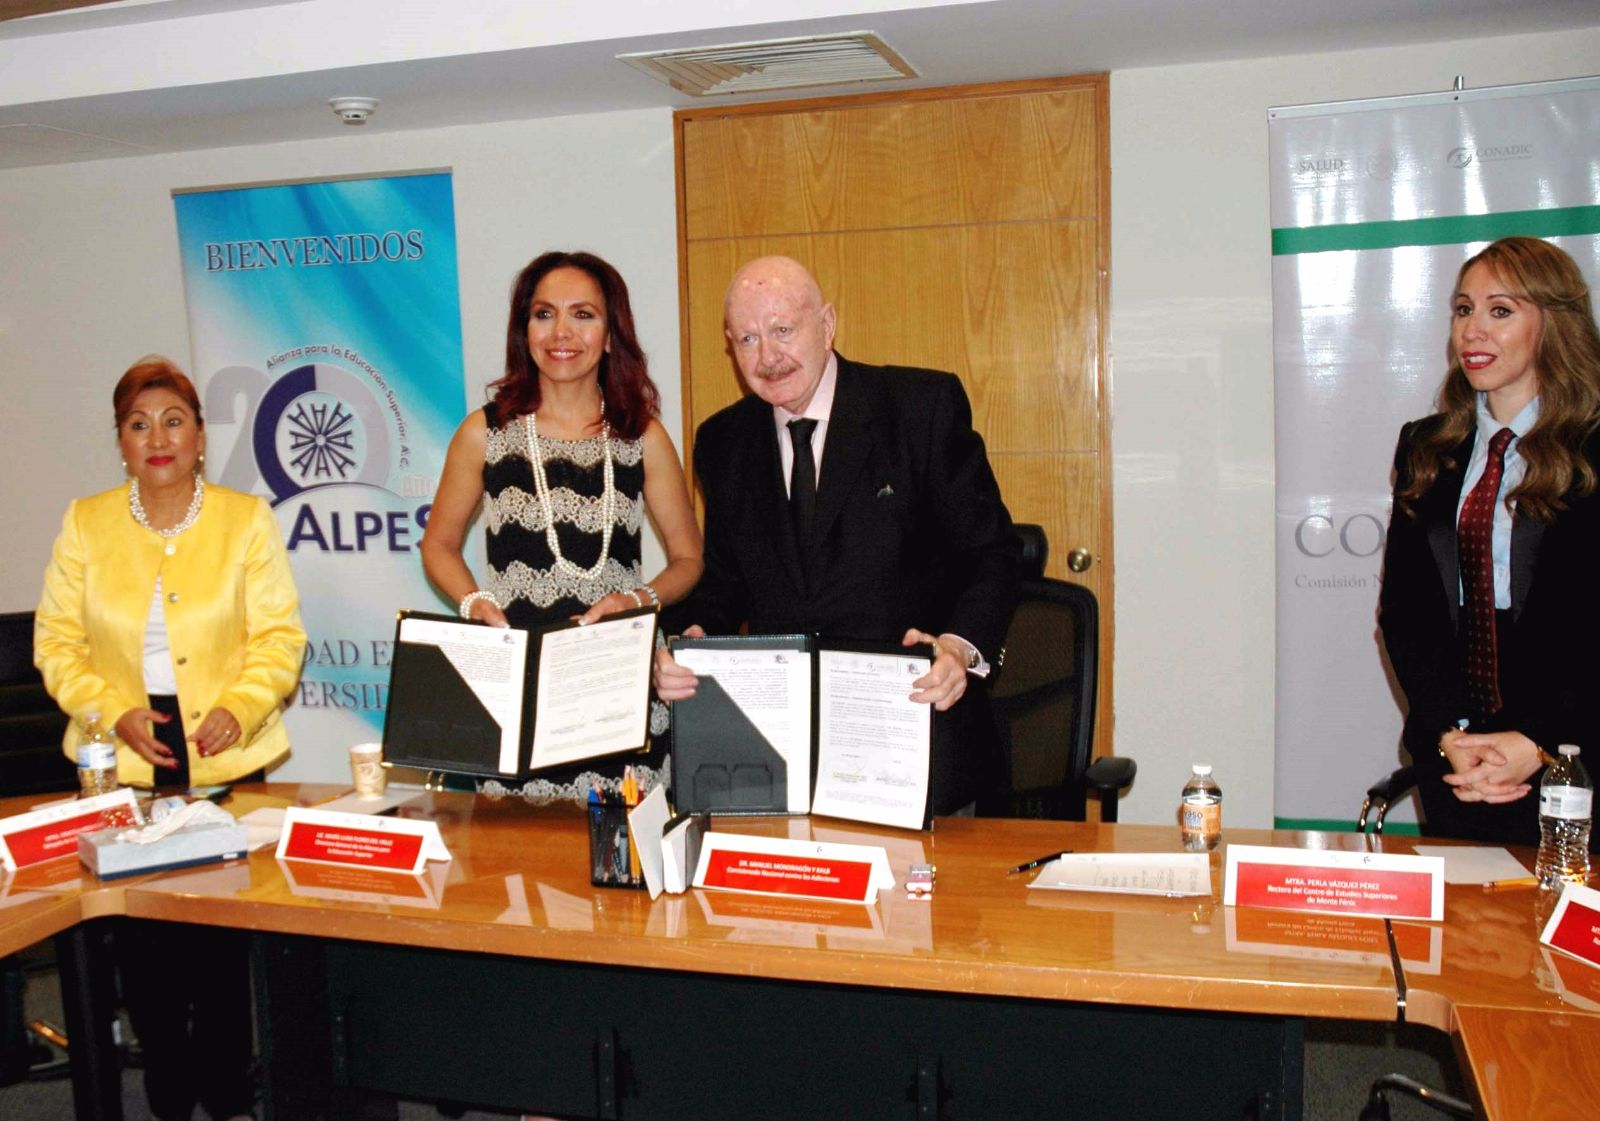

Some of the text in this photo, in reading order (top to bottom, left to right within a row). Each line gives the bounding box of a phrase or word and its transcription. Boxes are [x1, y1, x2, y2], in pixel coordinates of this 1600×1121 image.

[1476, 144, 1534, 157] CONADIC
[1297, 159, 1344, 174] SALUD
[205, 230, 424, 272] BIENVENIDOS
[266, 346, 302, 370] Alianza
[304, 345, 328, 355] para
[331, 344, 341, 356] la
[344, 349, 386, 390] Educación
[1295, 574, 1367, 589] Comisión
[368, 639, 393, 667] E
[1285, 877, 1380, 890] MTRA. PERLA VÁZQUEZ PÉREZ
[1267, 885, 1398, 900] Rectora del Centro de Estudios Superiores
[1306, 896, 1316, 904] de
[1316, 897, 1338, 905] Monte
